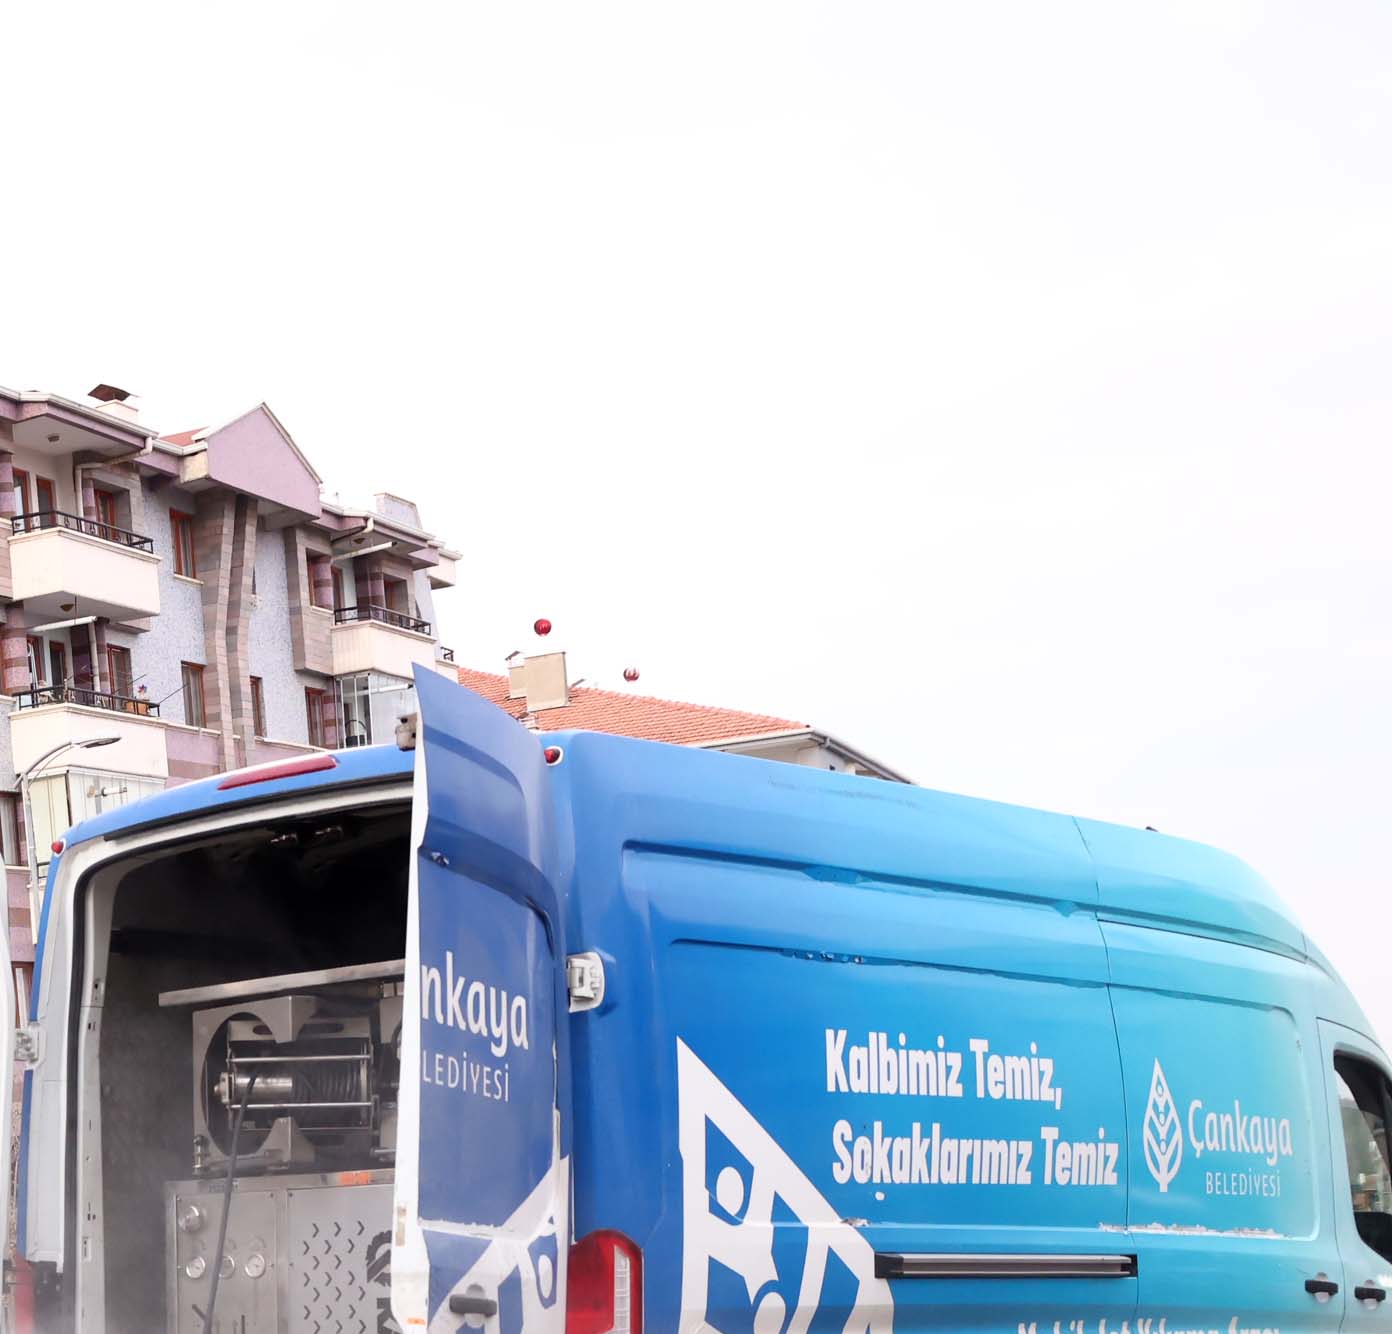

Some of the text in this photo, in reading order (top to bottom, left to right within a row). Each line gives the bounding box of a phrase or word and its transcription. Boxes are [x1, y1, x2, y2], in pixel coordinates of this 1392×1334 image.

[421, 951, 529, 1058] nkaya
[422, 1050, 509, 1103] LEDİYESİ
[825, 1028, 1063, 1110] Kalbimiz Temiz,
[832, 1119, 1119, 1186] Sokaklarımız Temiz
[1188, 1099, 1294, 1167] Çankaya
[1206, 1168, 1281, 1198] BELEDİYESİ
